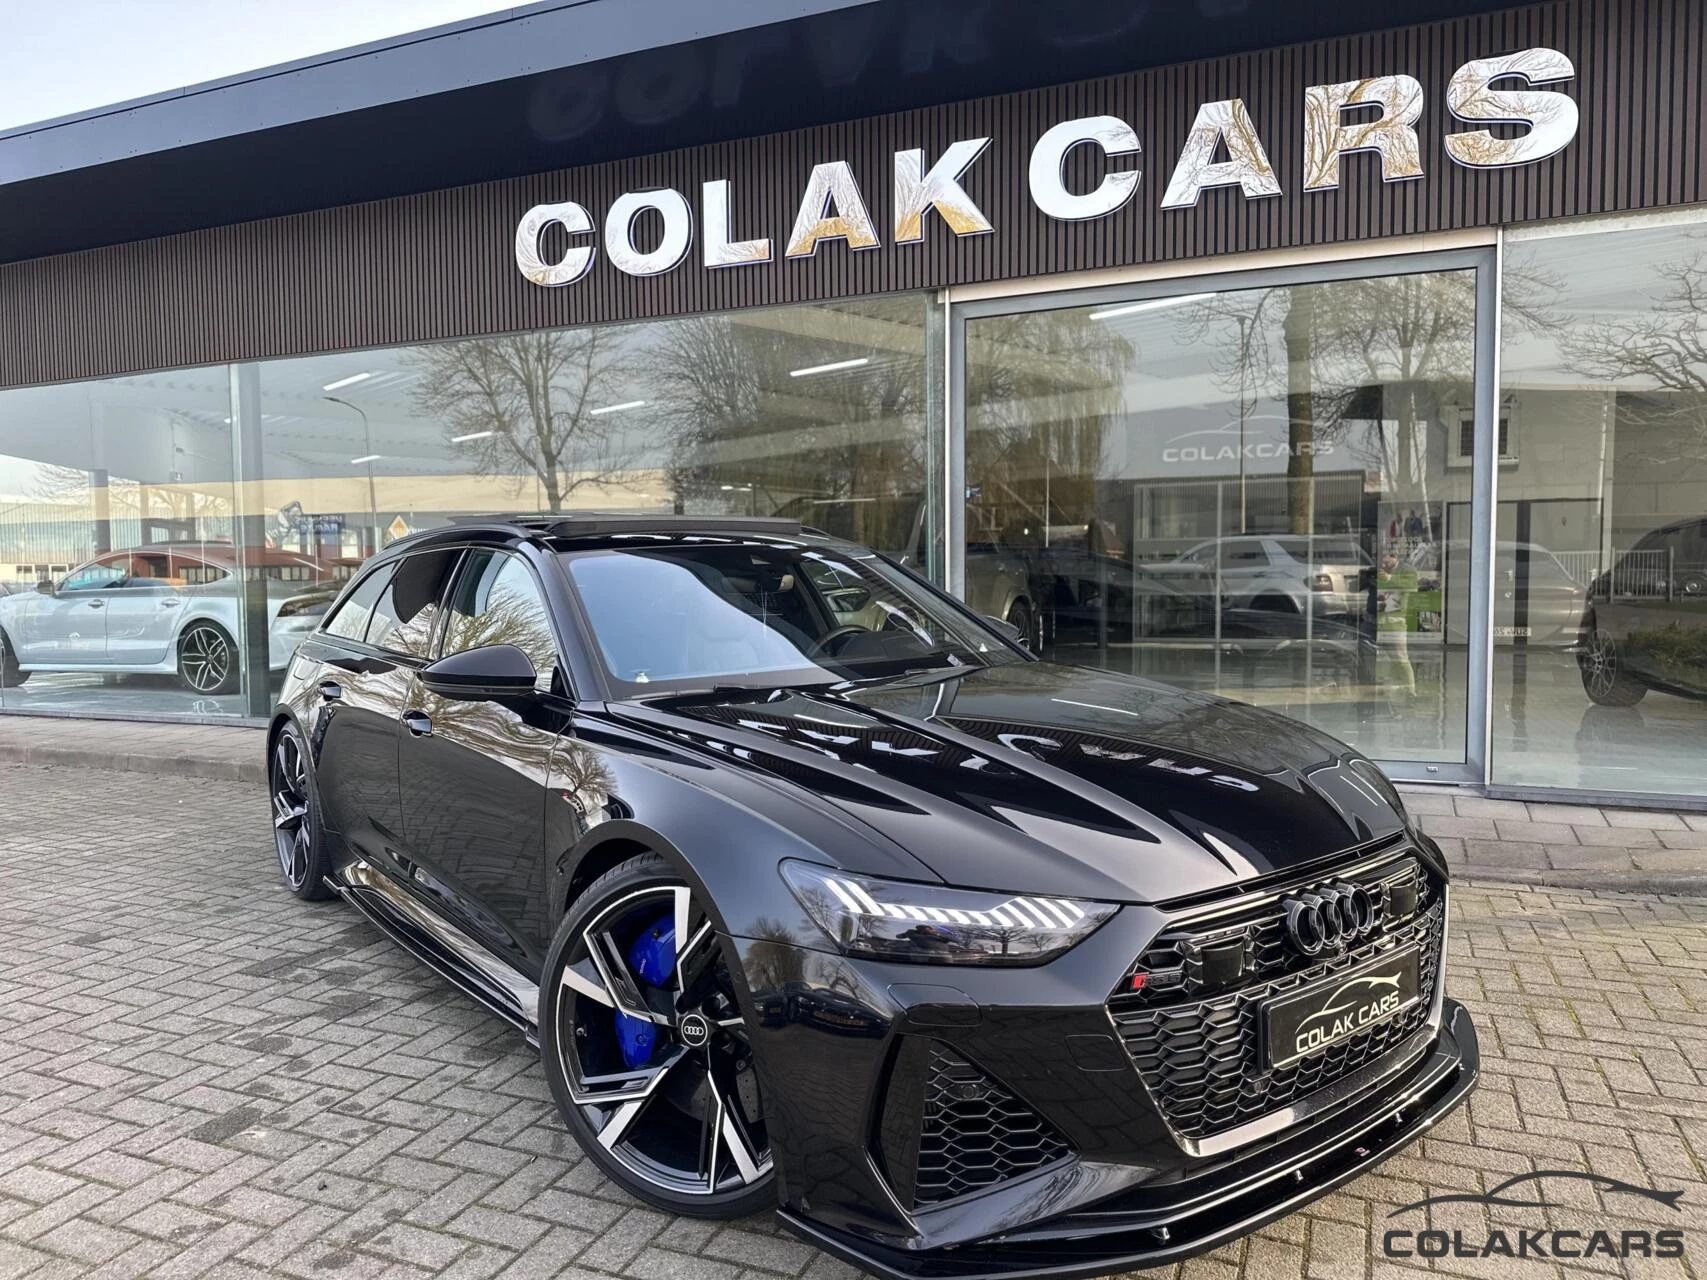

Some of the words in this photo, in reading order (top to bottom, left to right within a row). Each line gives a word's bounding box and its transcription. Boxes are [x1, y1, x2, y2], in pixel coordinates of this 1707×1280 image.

[515, 136, 995, 288] COLAK
[1028, 47, 1580, 222] CARS
[1162, 440, 1335, 463] COLAKCARS
[1295, 1011, 1356, 1053] COLAK
[1358, 990, 1400, 1025] CARS
